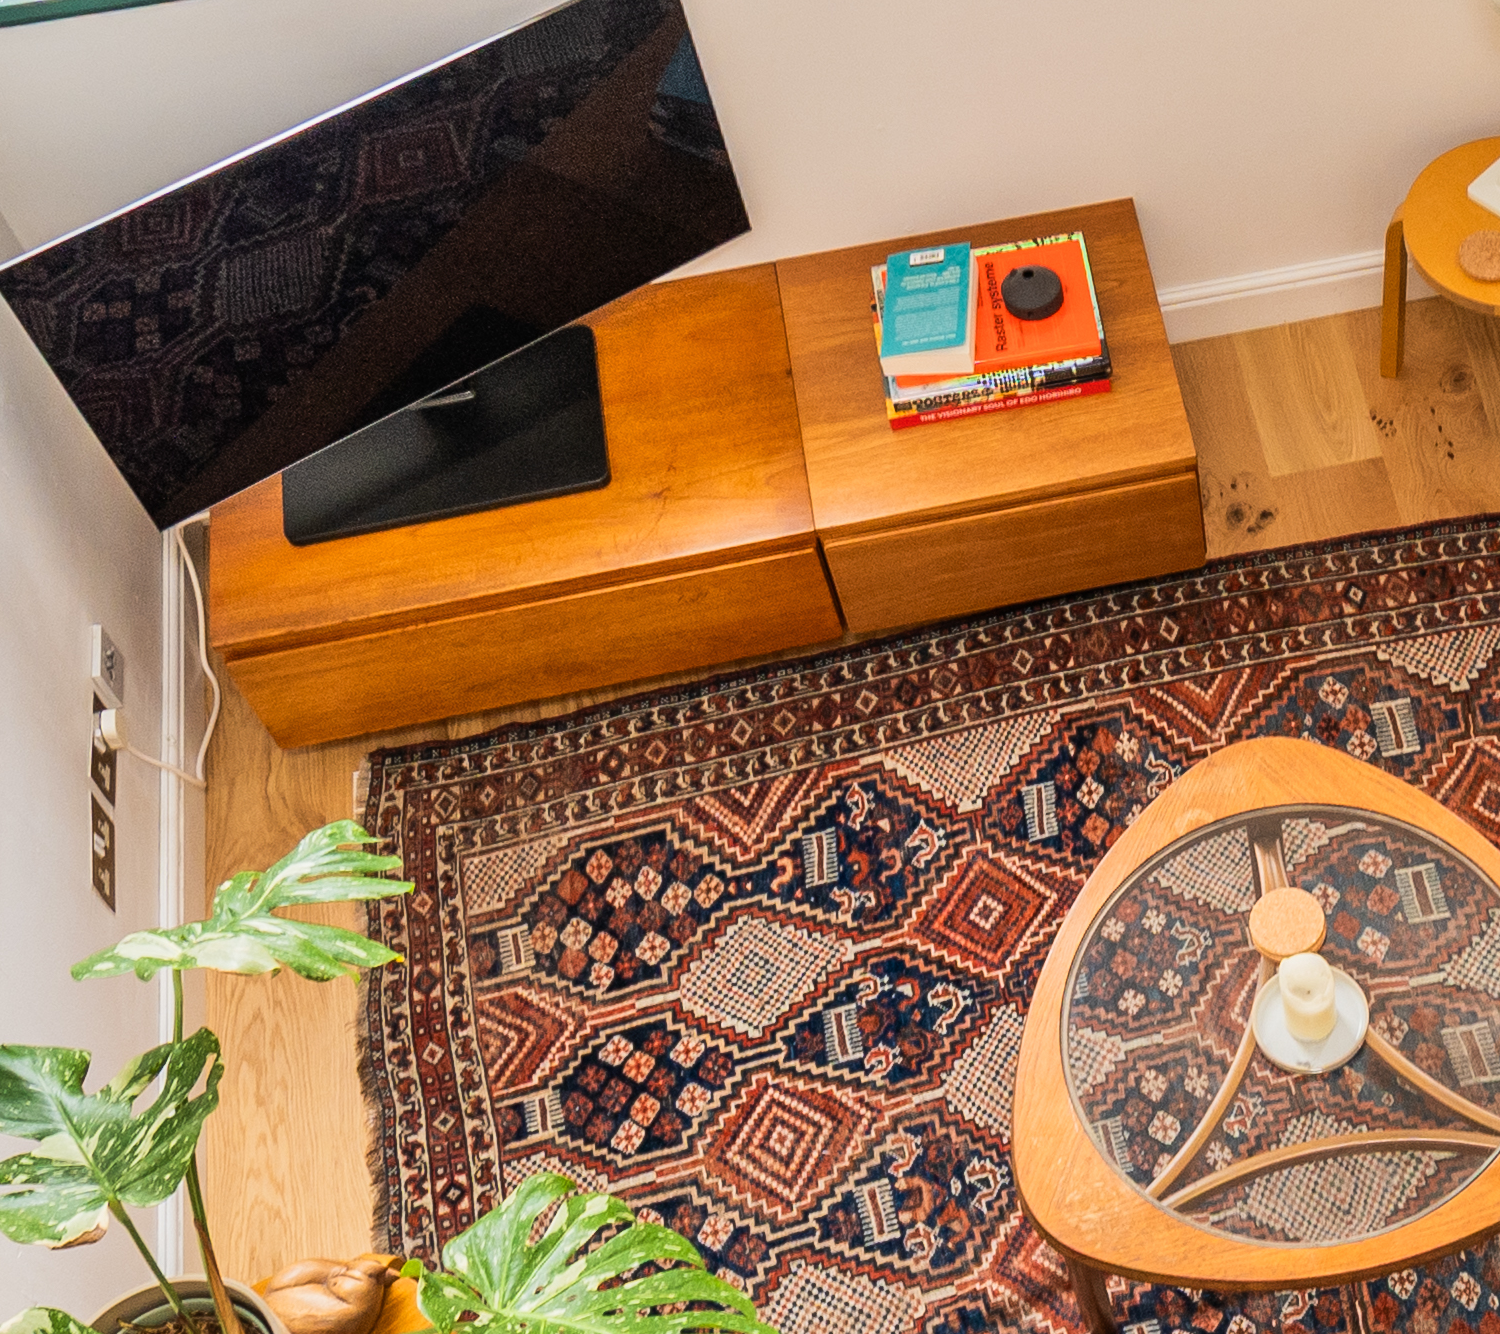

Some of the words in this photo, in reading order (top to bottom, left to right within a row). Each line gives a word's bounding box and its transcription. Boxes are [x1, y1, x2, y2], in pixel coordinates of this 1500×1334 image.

[985, 261, 1005, 309] systeme
[995, 311, 1009, 353] Raster
[920, 413, 935, 422] THE
[937, 405, 982, 419] VISIONARY
[983, 401, 1004, 411] SOUL
[1005, 398, 1018, 407] OF
[1019, 395, 1037, 404] EDO
